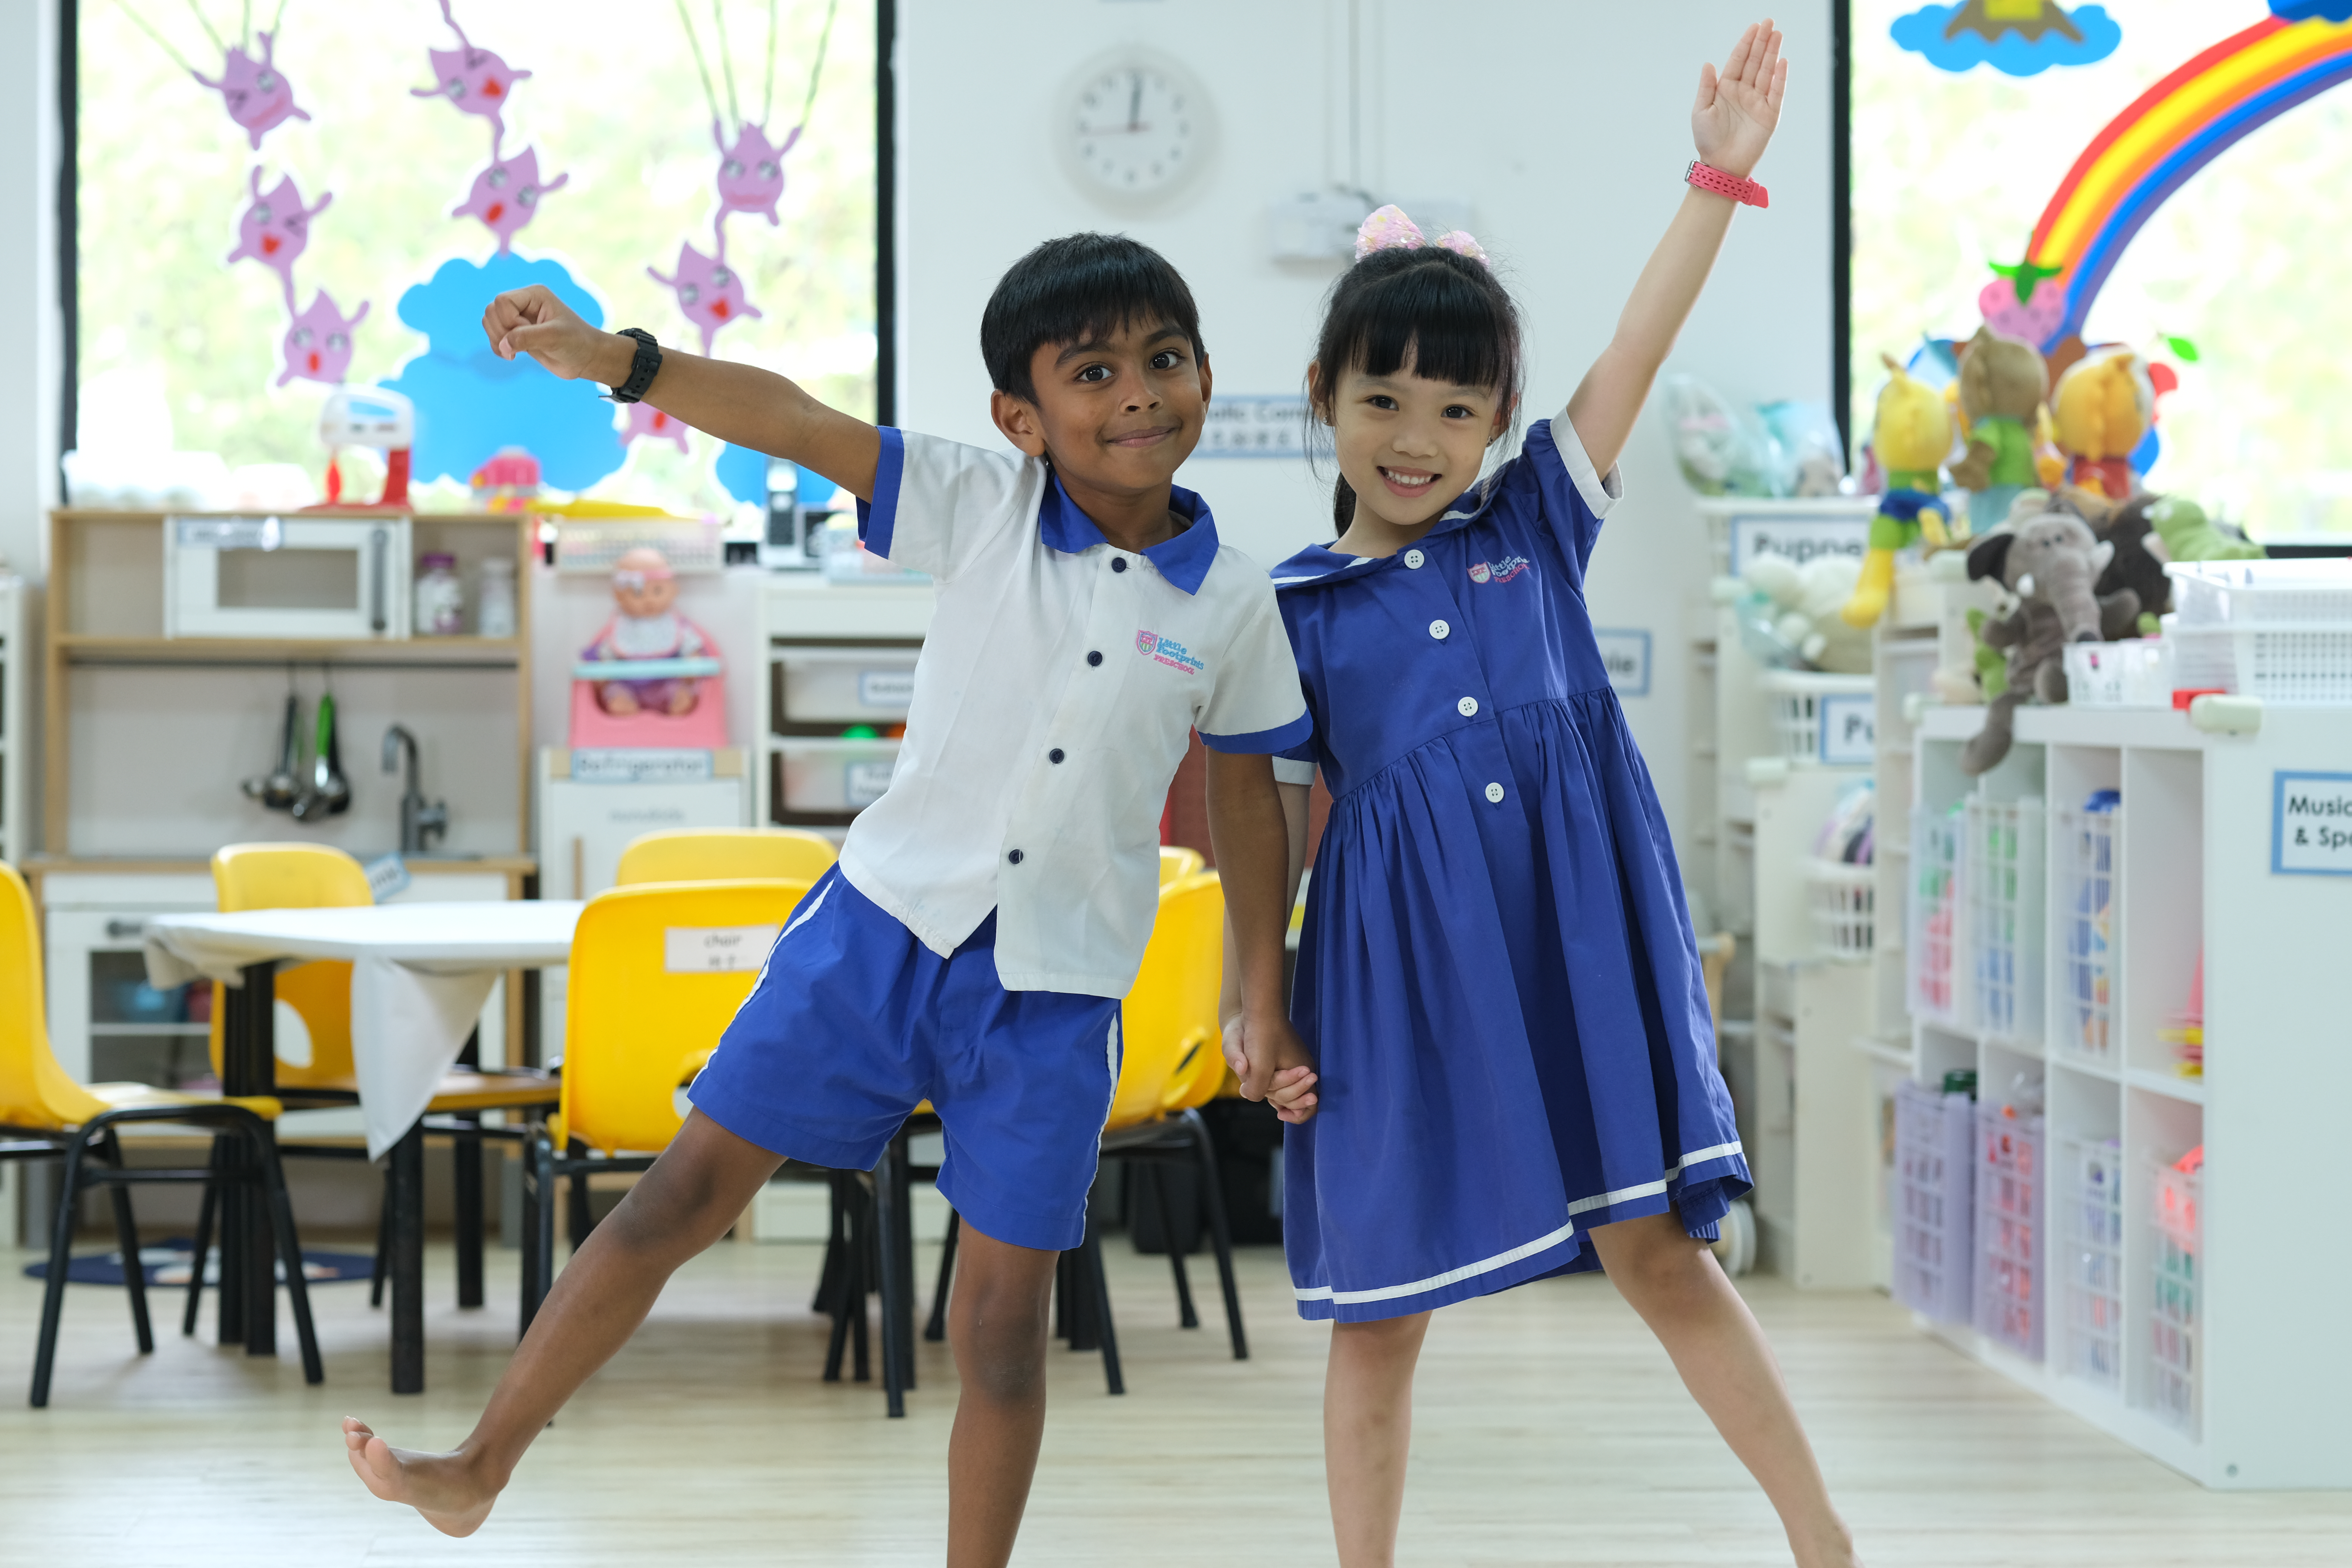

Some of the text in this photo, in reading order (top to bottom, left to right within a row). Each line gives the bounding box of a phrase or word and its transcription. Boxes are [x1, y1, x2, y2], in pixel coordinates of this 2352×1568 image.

[1487, 556, 1511, 571] Little
[1157, 637, 1187, 655] Little
[1153, 654, 1195, 675] PRESCHOOL
[1156, 645, 1204, 670] Footprints
[2288, 795, 2352, 816] Music
[2295, 825, 2352, 851] & Sp
